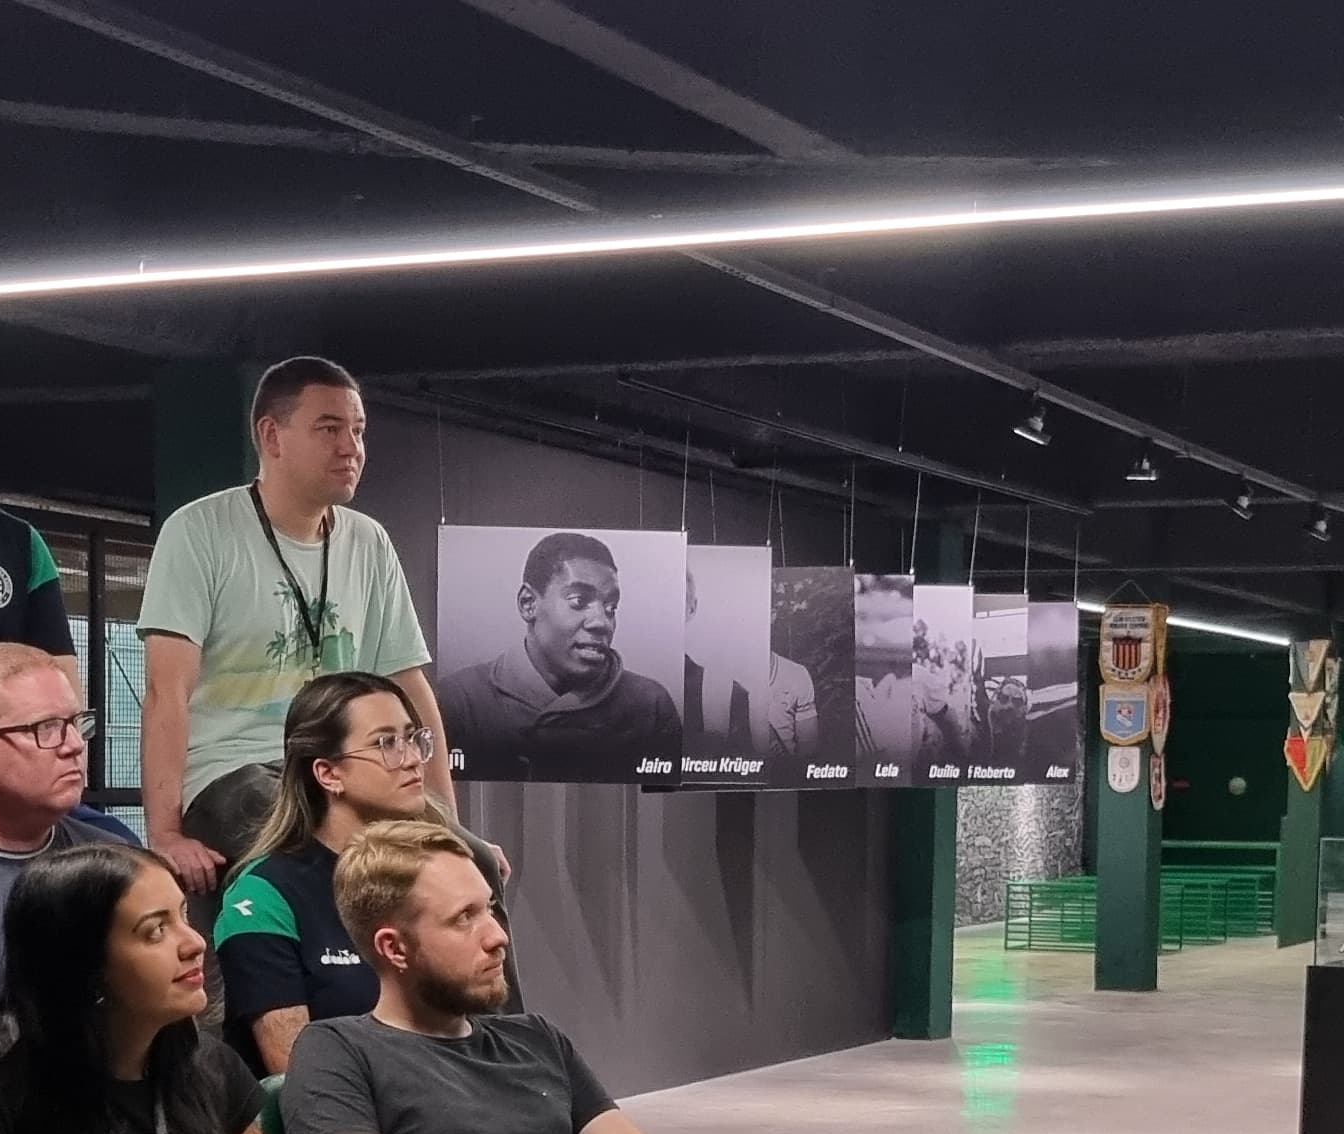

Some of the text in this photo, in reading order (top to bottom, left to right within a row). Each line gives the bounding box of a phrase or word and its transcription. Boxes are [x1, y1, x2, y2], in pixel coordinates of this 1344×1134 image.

[636, 757, 673, 774] Jairo
[719, 757, 764, 776] Krüger
[806, 764, 848, 779] Fedato
[875, 763, 899, 777] Lela
[973, 765, 1015, 779] Roberto
[1046, 765, 1070, 778] Alex
